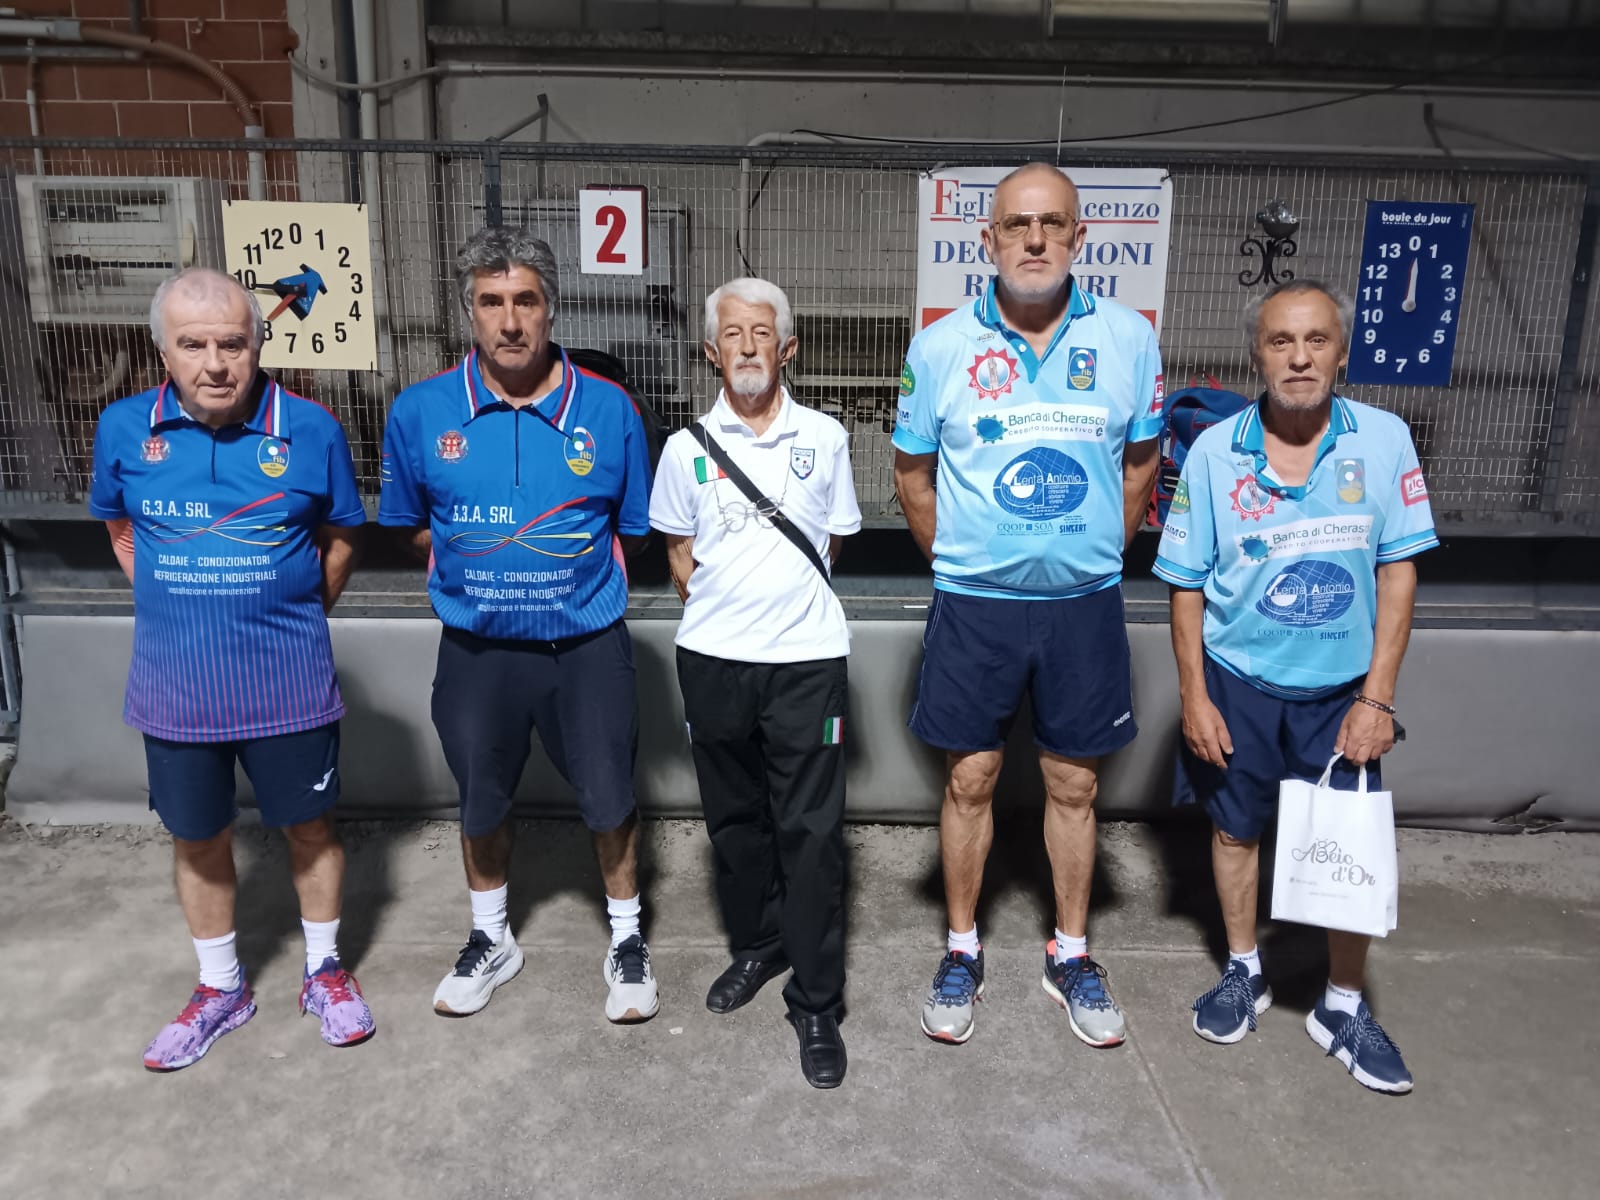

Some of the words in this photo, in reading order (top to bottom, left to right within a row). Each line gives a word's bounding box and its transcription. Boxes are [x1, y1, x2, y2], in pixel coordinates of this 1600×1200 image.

[931, 179, 994, 224] Figli
[1080, 202, 1160, 218] cenzo
[1382, 211, 1411, 222] boule
[1414, 212, 1427, 223] du
[1428, 213, 1451, 226] jour
[261, 228, 284, 250] 12
[290, 223, 301, 244] 0
[315, 229, 324, 250] 1
[595, 205, 627, 263] 2
[1379, 243, 1401, 258] 13
[1409, 236, 1421, 251] 0
[243, 244, 262, 265] 11
[338, 246, 351, 268] 2
[1429, 244, 1438, 259] 1
[1366, 264, 1388, 279] 12
[1440, 264, 1453, 279] 2
[351, 273, 363, 294] 3
[1362, 287, 1383, 301] 11
[1444, 287, 1456, 301] 3
[349, 300, 362, 322] 4
[1362, 309, 1384, 323] 10
[1440, 310, 1452, 323] 4
[335, 322, 347, 343] 5
[1364, 329, 1377, 344] 9
[1433, 330, 1445, 344] 5
[285, 333, 297, 354] 7
[312, 333, 325, 354] 6
[1374, 349, 1386, 363] 8
[1418, 349, 1431, 363] 6
[1395, 358, 1408, 373] 7
[1008, 412, 1042, 427] Banca
[1043, 412, 1051, 422] di
[1052, 411, 1106, 426] Cherasco
[1046, 472, 1082, 483] Antonio
[142, 500, 181, 517] G.3.A.
[185, 502, 213, 519] SRL
[490, 506, 516, 524] SRL
[1272, 529, 1309, 545] Banca
[1311, 527, 1320, 537] di
[158, 554, 189, 566] CALDAIE
[198, 555, 271, 567] CONDIZIONATORI
[222, 570, 277, 584] INDUSTRIALE
[464, 568, 496, 582] CALDAIE
[504, 568, 575, 583] CONDIZIONATORI
[1312, 583, 1351, 594] Antonio
[1331, 865, 1376, 886] d'Or
